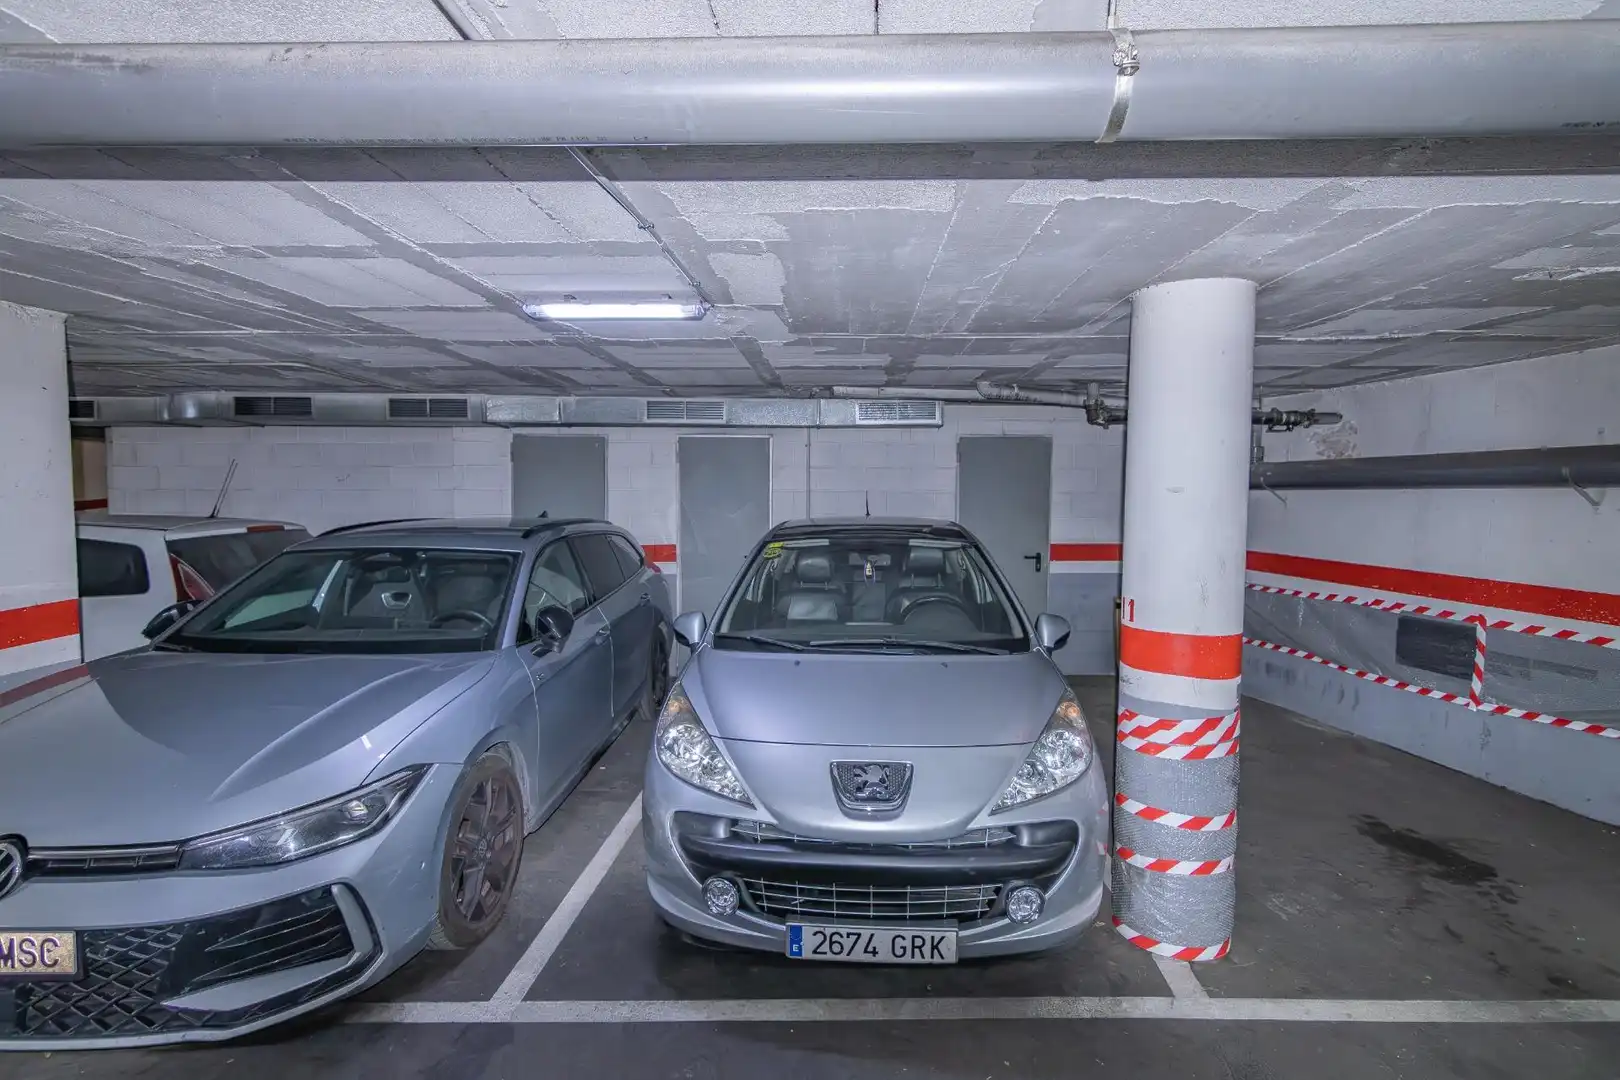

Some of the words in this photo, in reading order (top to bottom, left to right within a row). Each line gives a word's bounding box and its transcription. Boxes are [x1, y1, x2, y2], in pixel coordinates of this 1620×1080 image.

[792, 944, 800, 952] E
[811, 930, 879, 958] 2674
[891, 934, 946, 960] GRK
